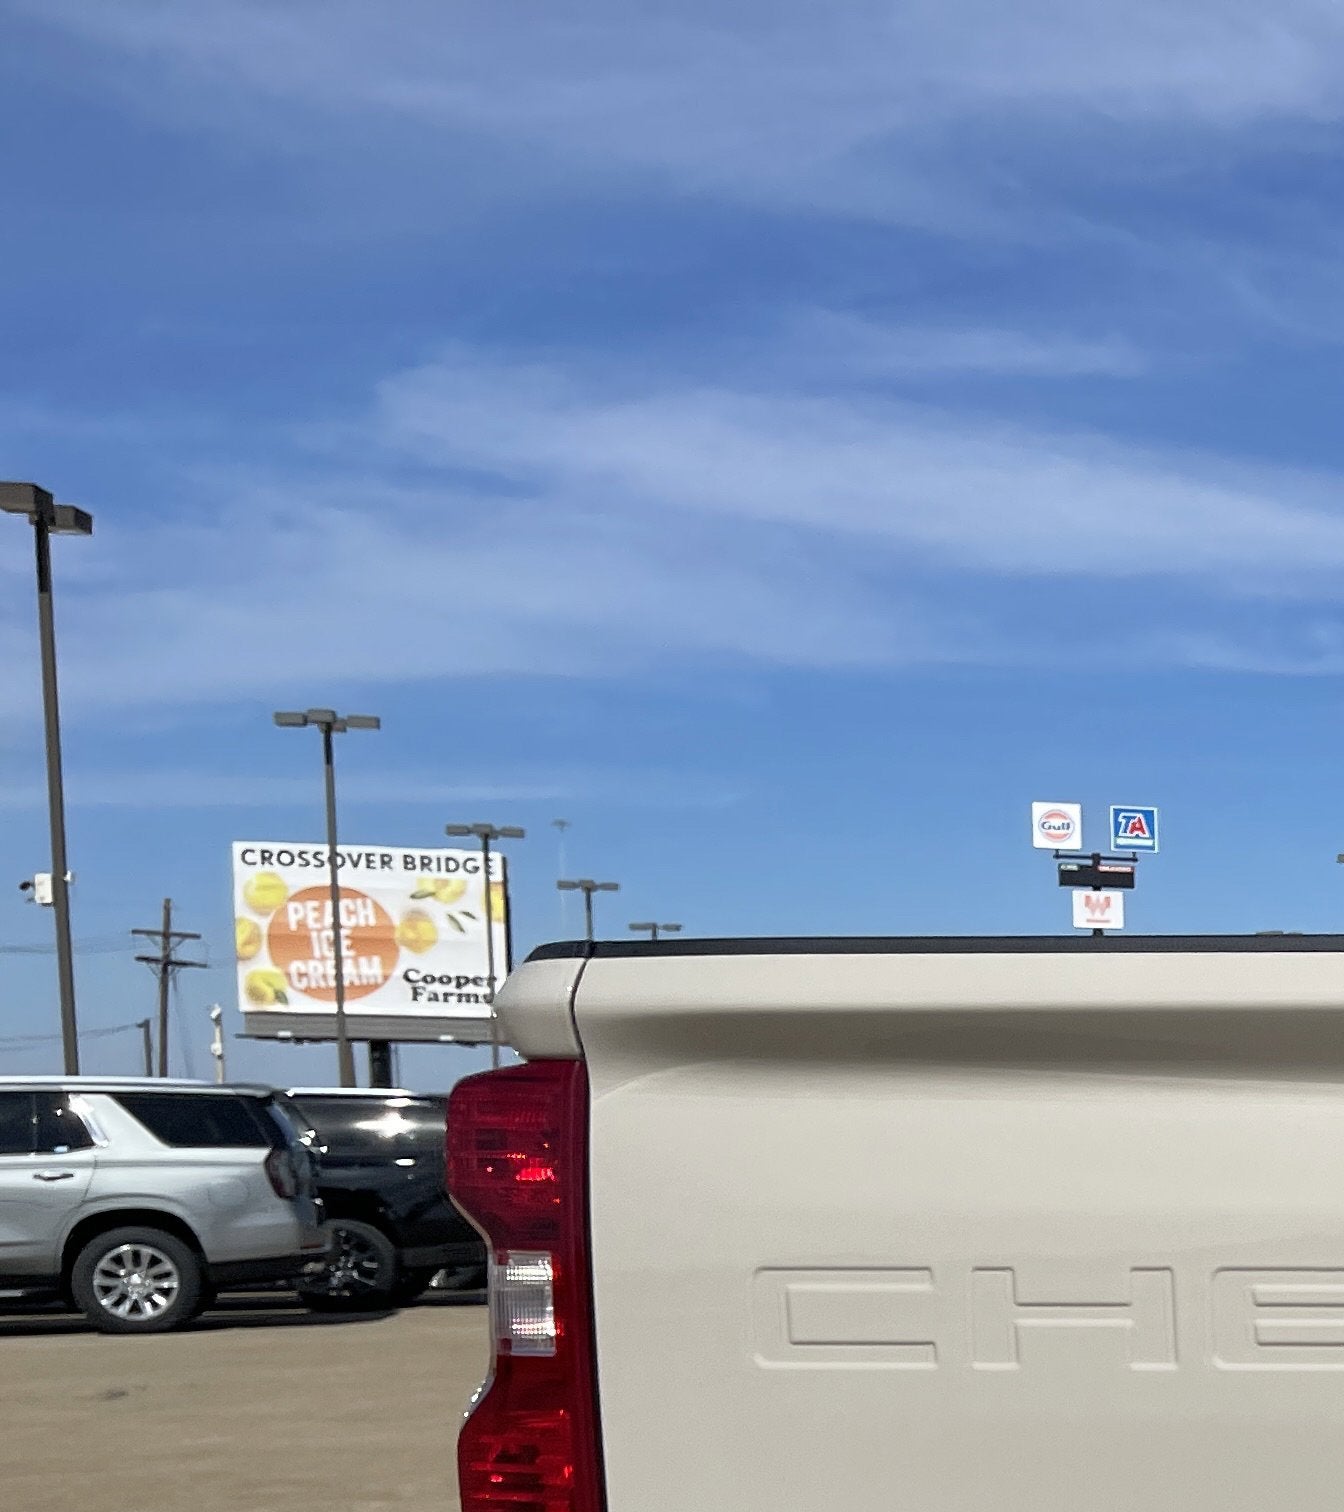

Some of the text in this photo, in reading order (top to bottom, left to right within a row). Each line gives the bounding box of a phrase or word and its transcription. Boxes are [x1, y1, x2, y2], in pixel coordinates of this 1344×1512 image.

[240, 849, 497, 875] CROSSOVER BRIDGE
[287, 898, 377, 931] PEACH
[311, 930, 356, 959] ICE
[289, 956, 384, 990] CREAM
